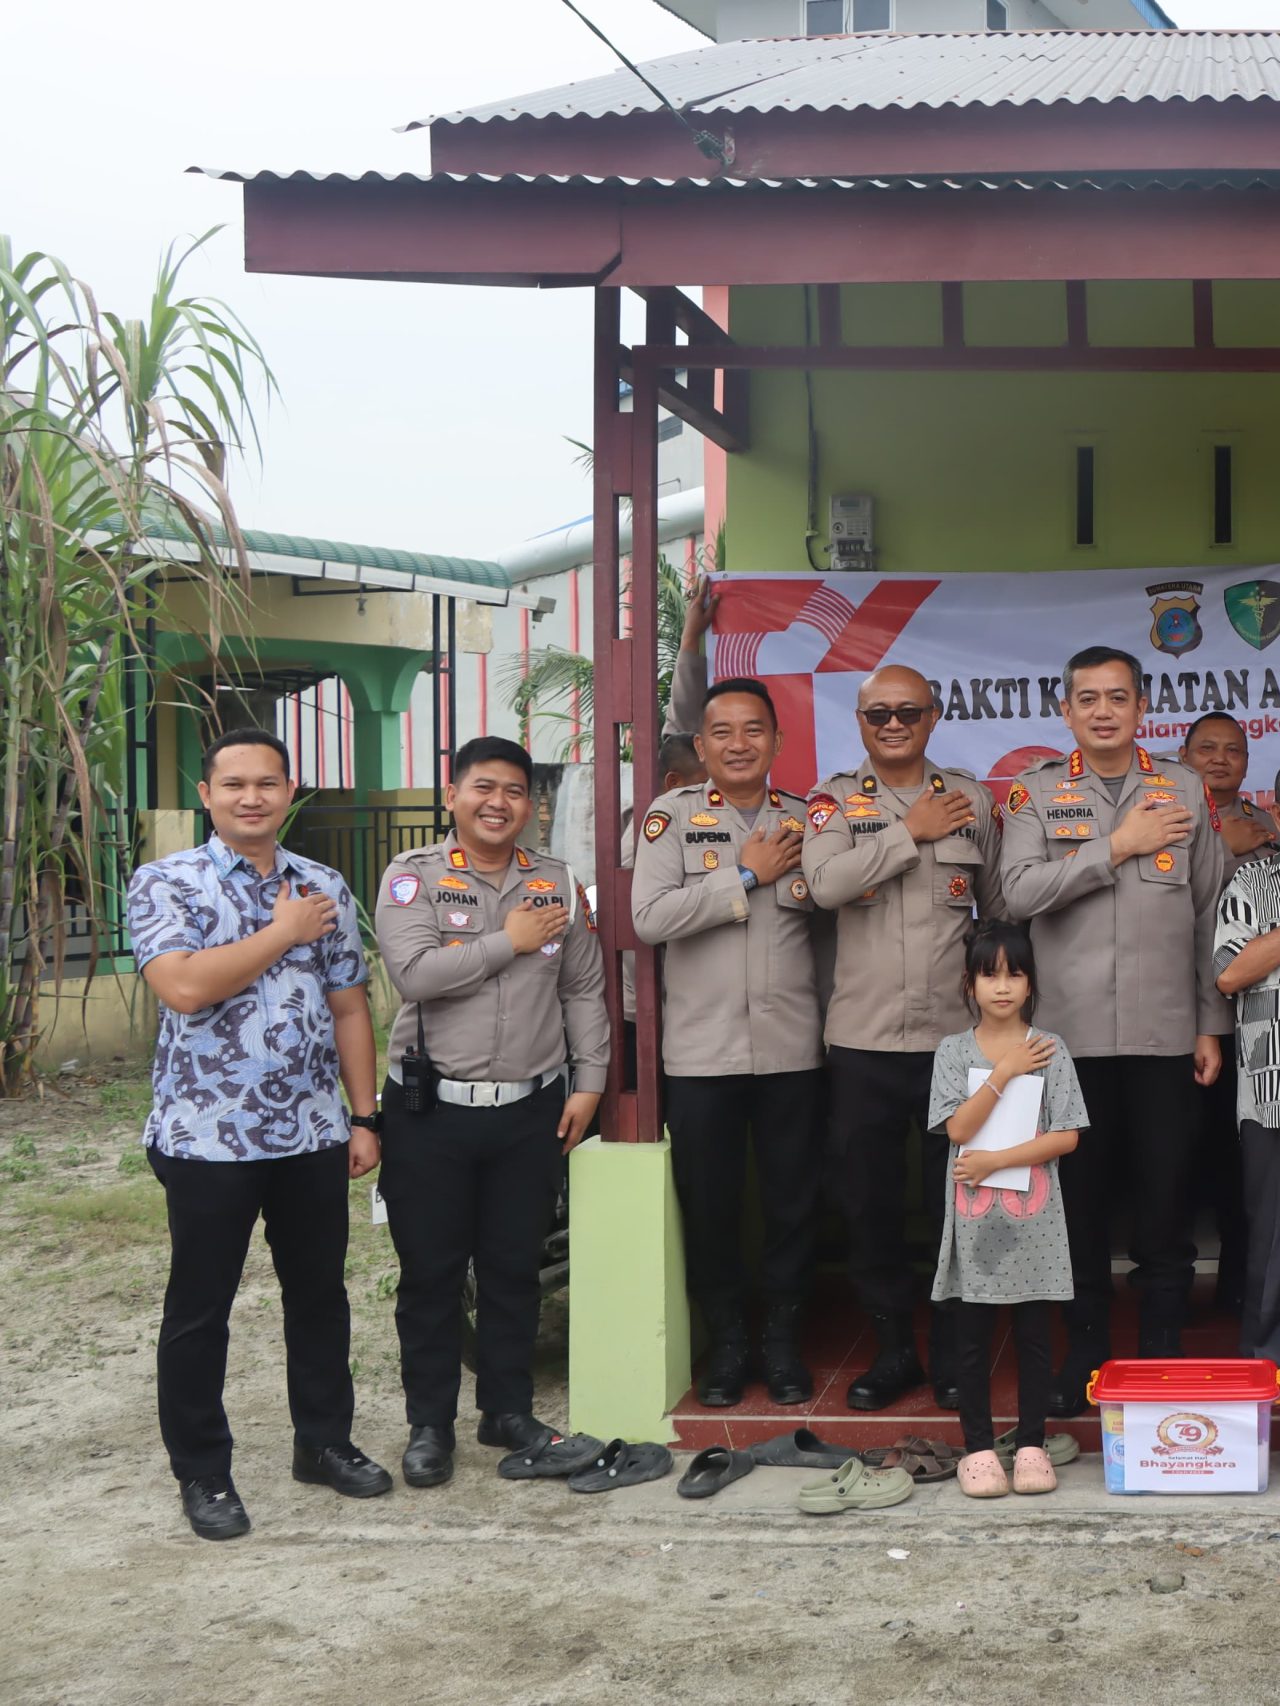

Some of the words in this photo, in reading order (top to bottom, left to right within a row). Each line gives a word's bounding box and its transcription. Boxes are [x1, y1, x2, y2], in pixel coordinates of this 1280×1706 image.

[1046, 808, 1094, 820] HENDRIA
[435, 891, 478, 907] JOHAN
[1139, 1460, 1237, 1469] Bhayangkara
